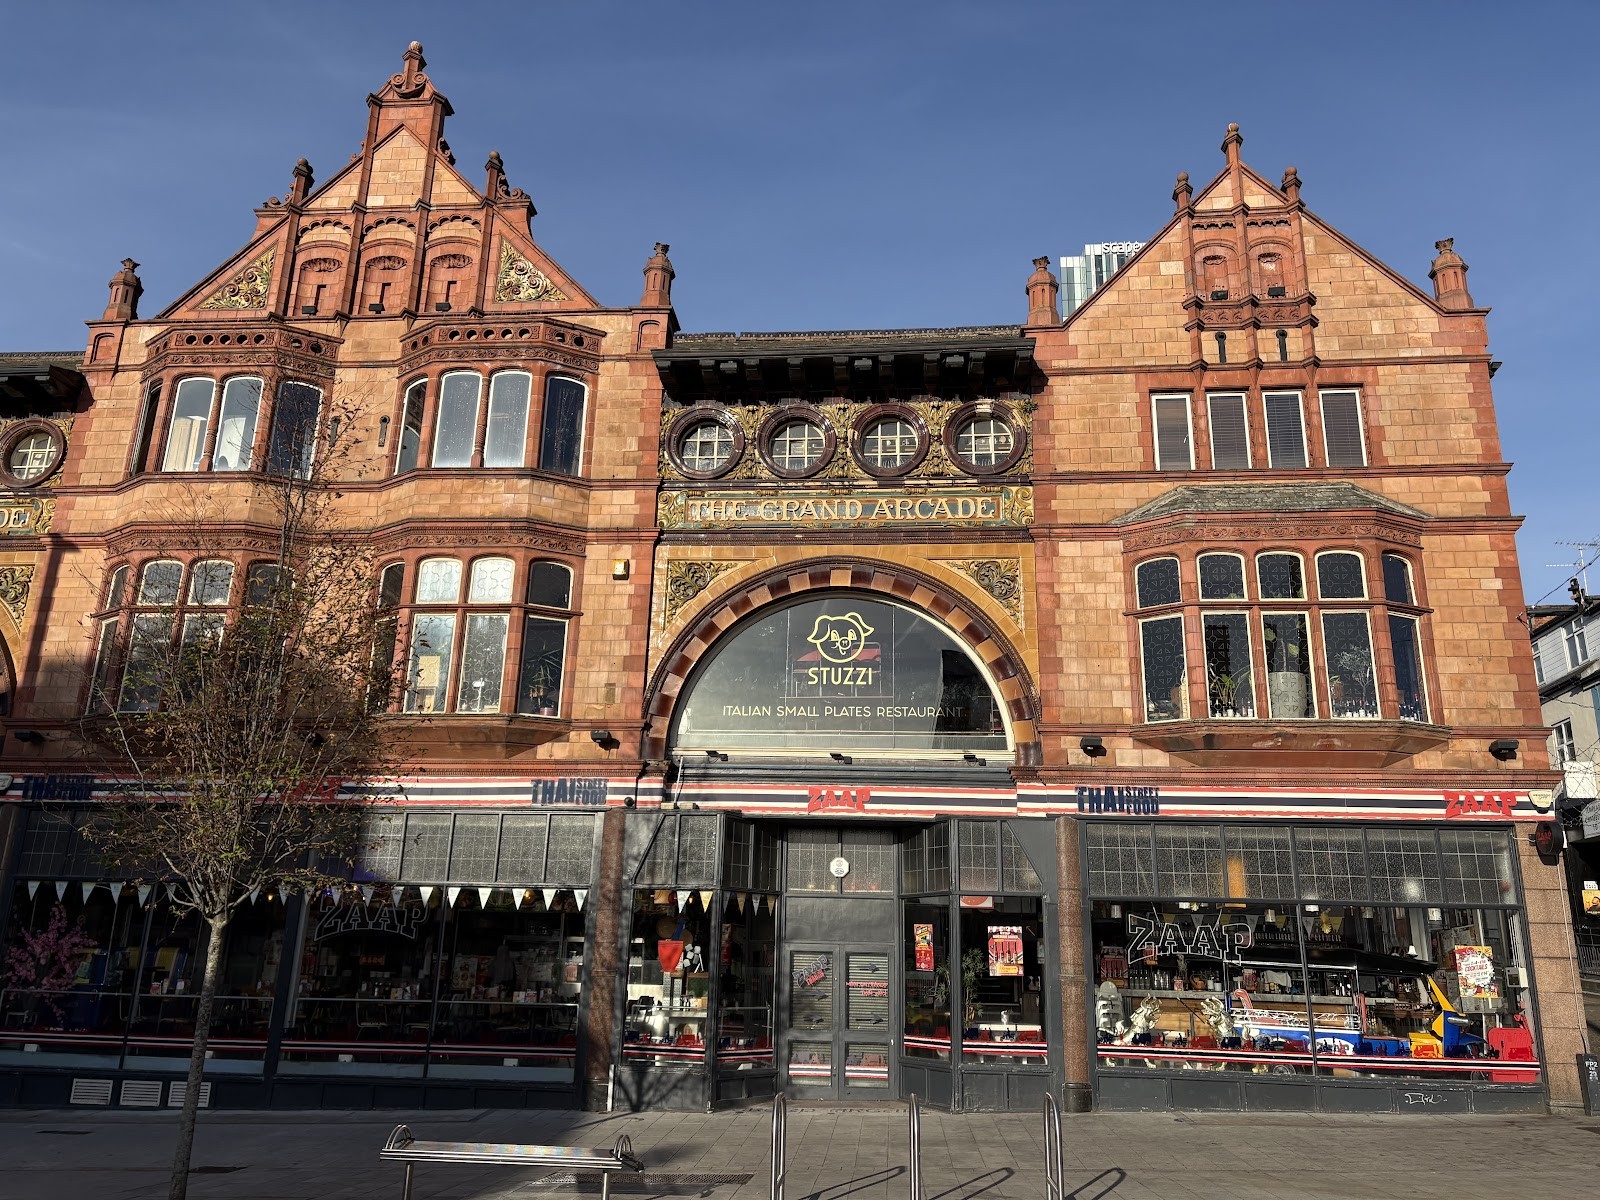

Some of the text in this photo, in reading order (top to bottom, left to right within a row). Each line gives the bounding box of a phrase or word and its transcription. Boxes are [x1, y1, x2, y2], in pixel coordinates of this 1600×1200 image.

[1102, 241, 1140, 256] scape
[688, 498, 995, 521] THE GRAND ARCADE
[807, 667, 873, 685] STUZZI
[722, 705, 964, 718] ITALIAN SMALL PLATES RESTAURANT
[531, 778, 576, 805] THAI
[575, 778, 609, 790] STREET
[1126, 786, 1159, 799] STREET
[575, 789, 607, 806] FOOD
[808, 786, 870, 814] ZAAP
[1075, 786, 1126, 814] THAI
[1126, 798, 1159, 815] FOOD
[1443, 790, 1517, 819] ZAAP
[314, 893, 430, 941] ZAAP
[1128, 914, 1252, 966] ZAAP
[792, 954, 828, 987] ZAAP
